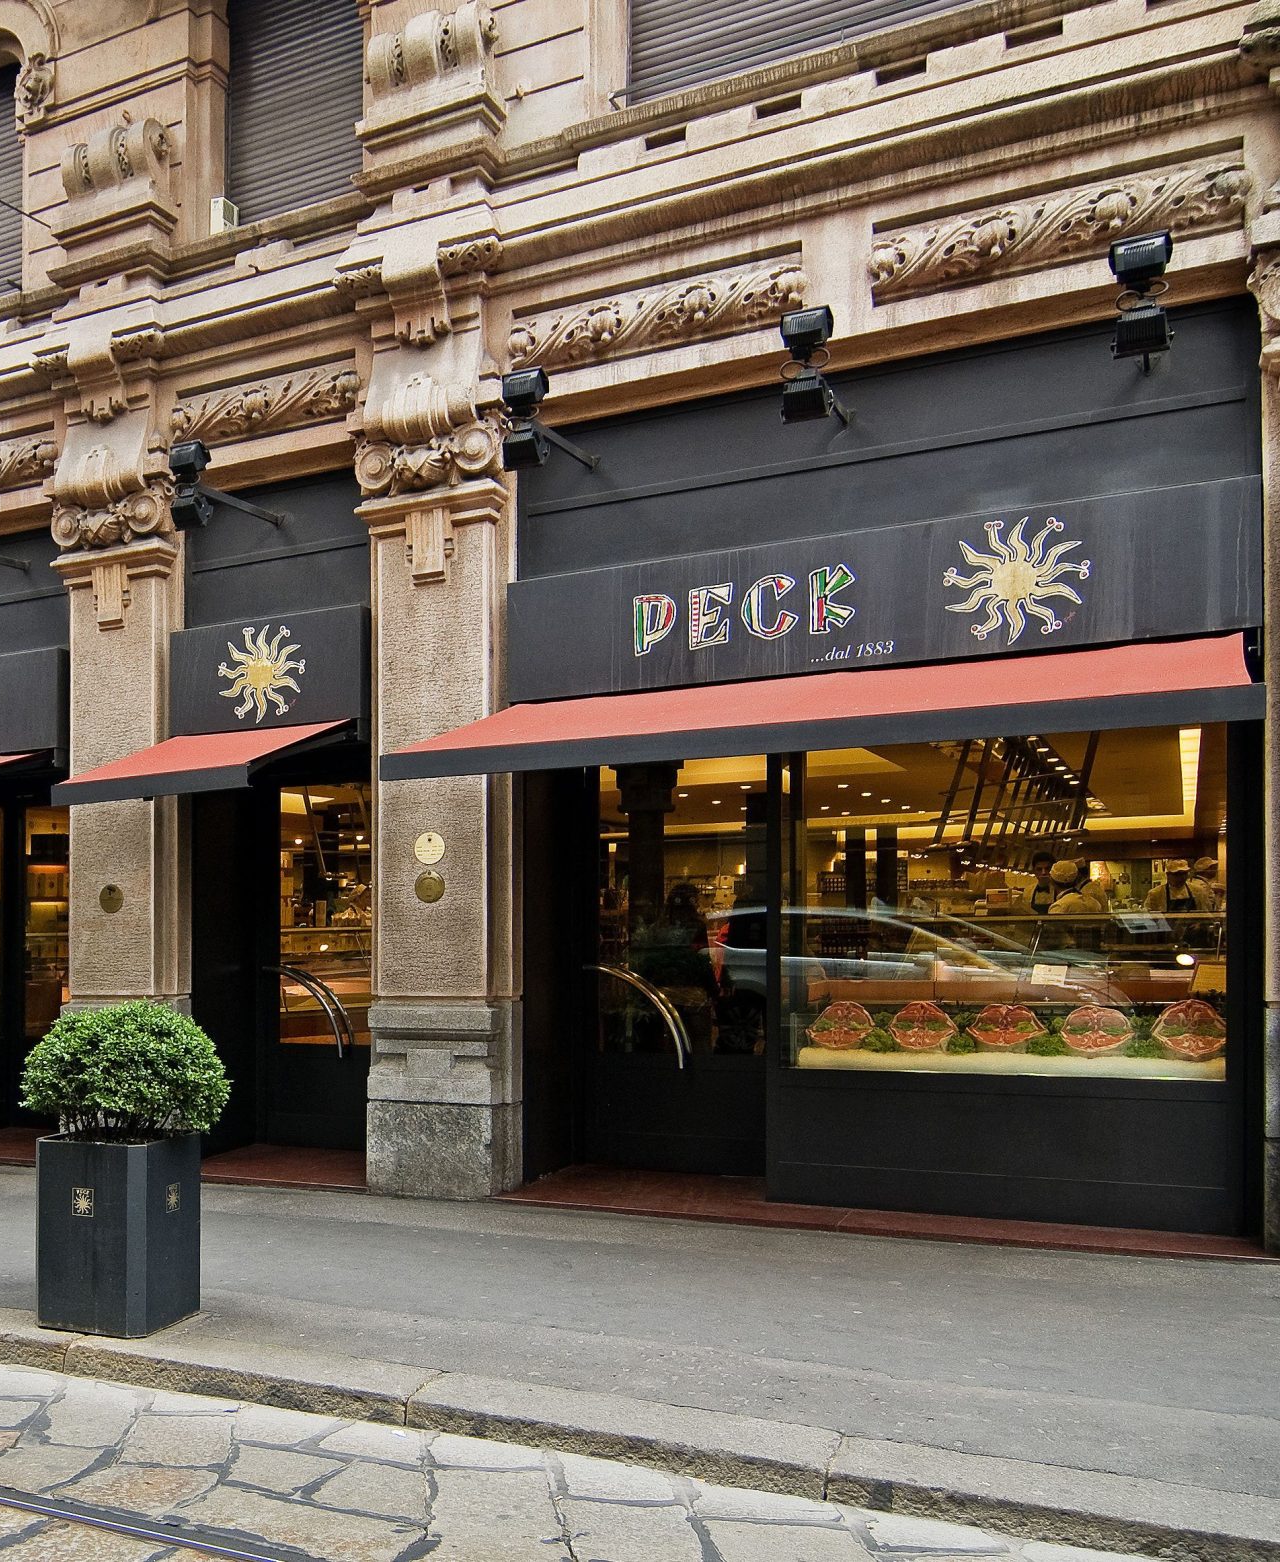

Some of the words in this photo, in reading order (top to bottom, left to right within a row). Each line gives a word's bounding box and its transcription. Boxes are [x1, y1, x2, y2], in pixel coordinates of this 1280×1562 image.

[633, 563, 856, 657] PECK
[810, 645, 850, 663] ...dal
[855, 640, 895, 658] 1883
